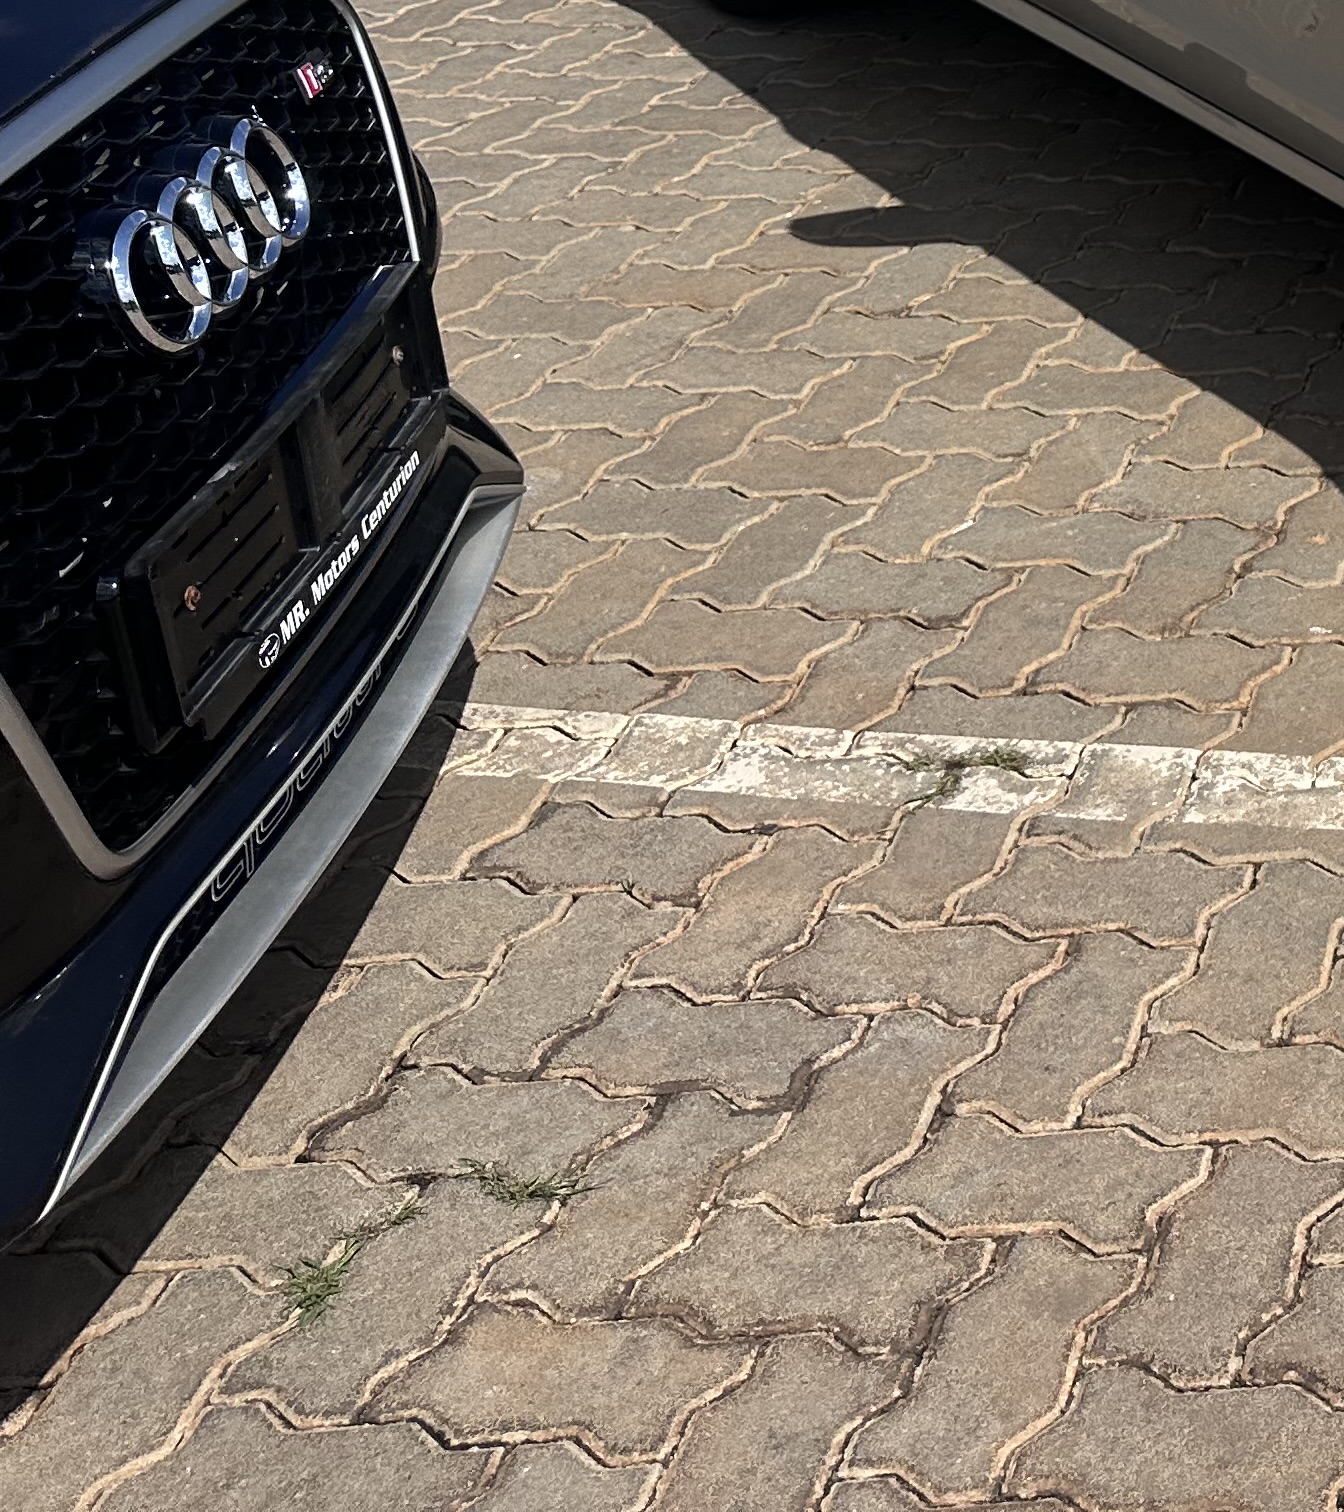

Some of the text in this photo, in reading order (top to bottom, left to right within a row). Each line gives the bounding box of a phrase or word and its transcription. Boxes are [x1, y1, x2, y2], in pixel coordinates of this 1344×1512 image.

[279, 450, 421, 645] MR. Motors Centurion
